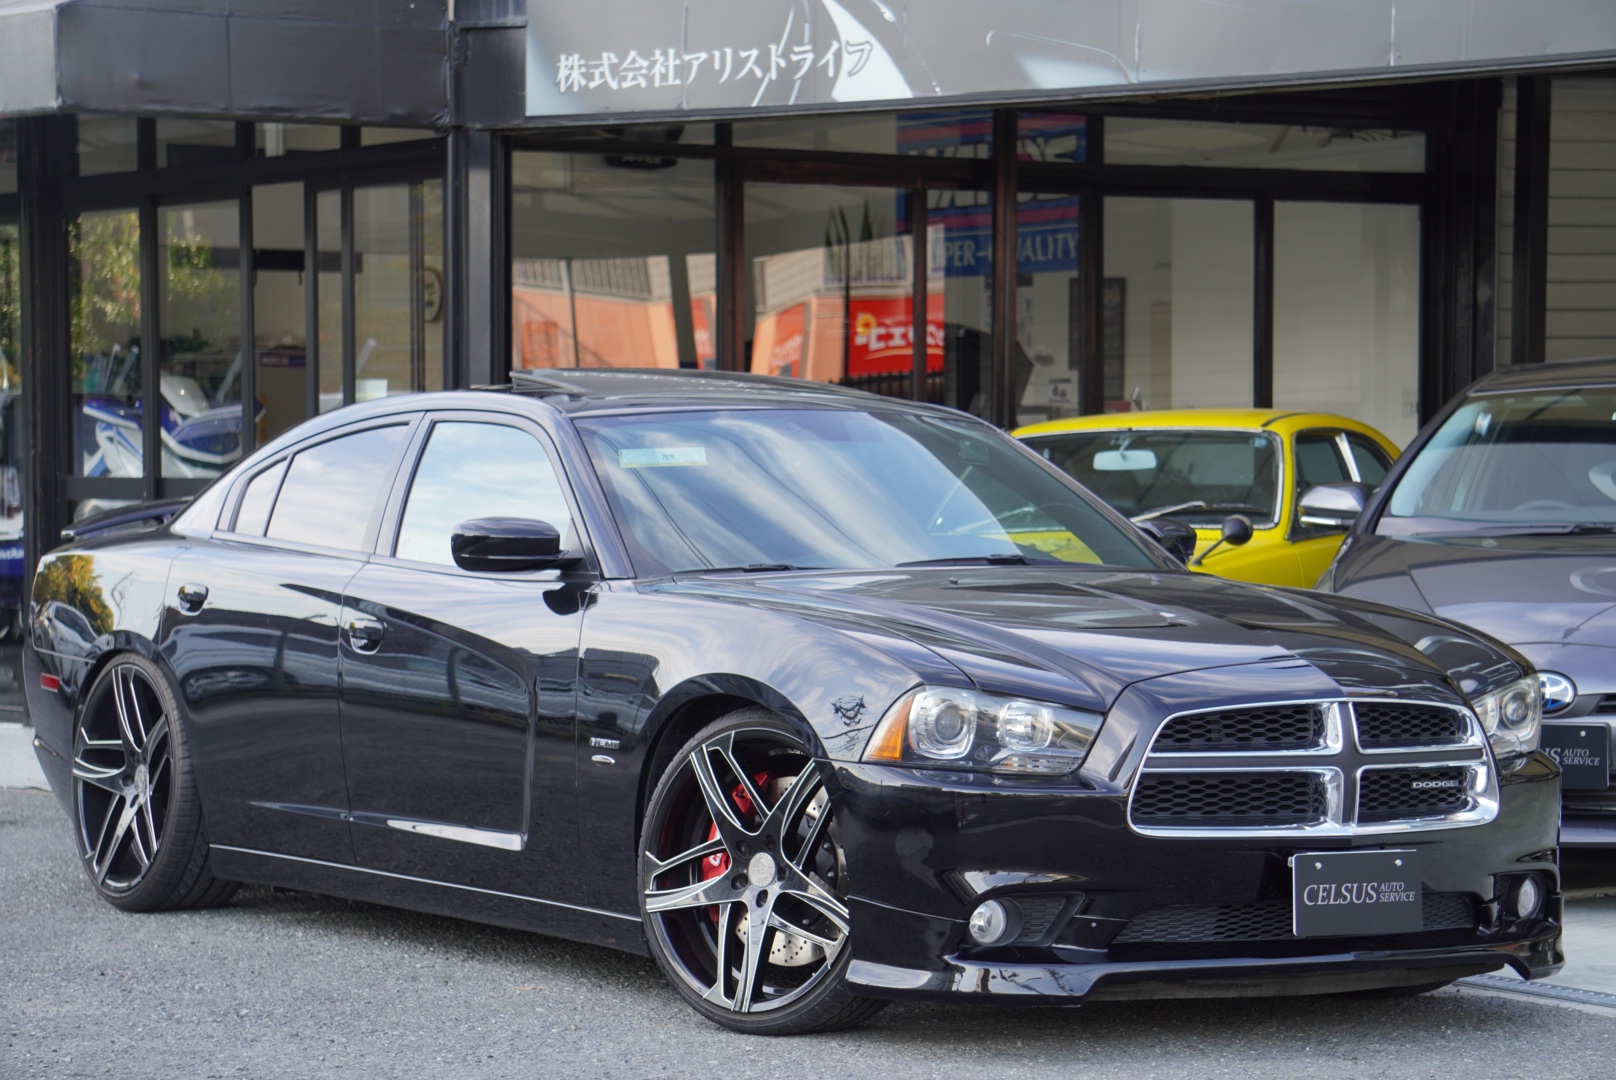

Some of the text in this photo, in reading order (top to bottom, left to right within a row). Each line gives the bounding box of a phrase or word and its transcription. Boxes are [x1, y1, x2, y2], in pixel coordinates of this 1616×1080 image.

[555, 40, 874, 93] 株式会社アリストライフ
[1562, 748, 1589, 757] AUTO
[1563, 757, 1600, 766] SERVICE
[1379, 882, 1404, 892] AUTO
[1303, 882, 1377, 905] CELSUS
[1379, 891, 1415, 902] SERVICE
